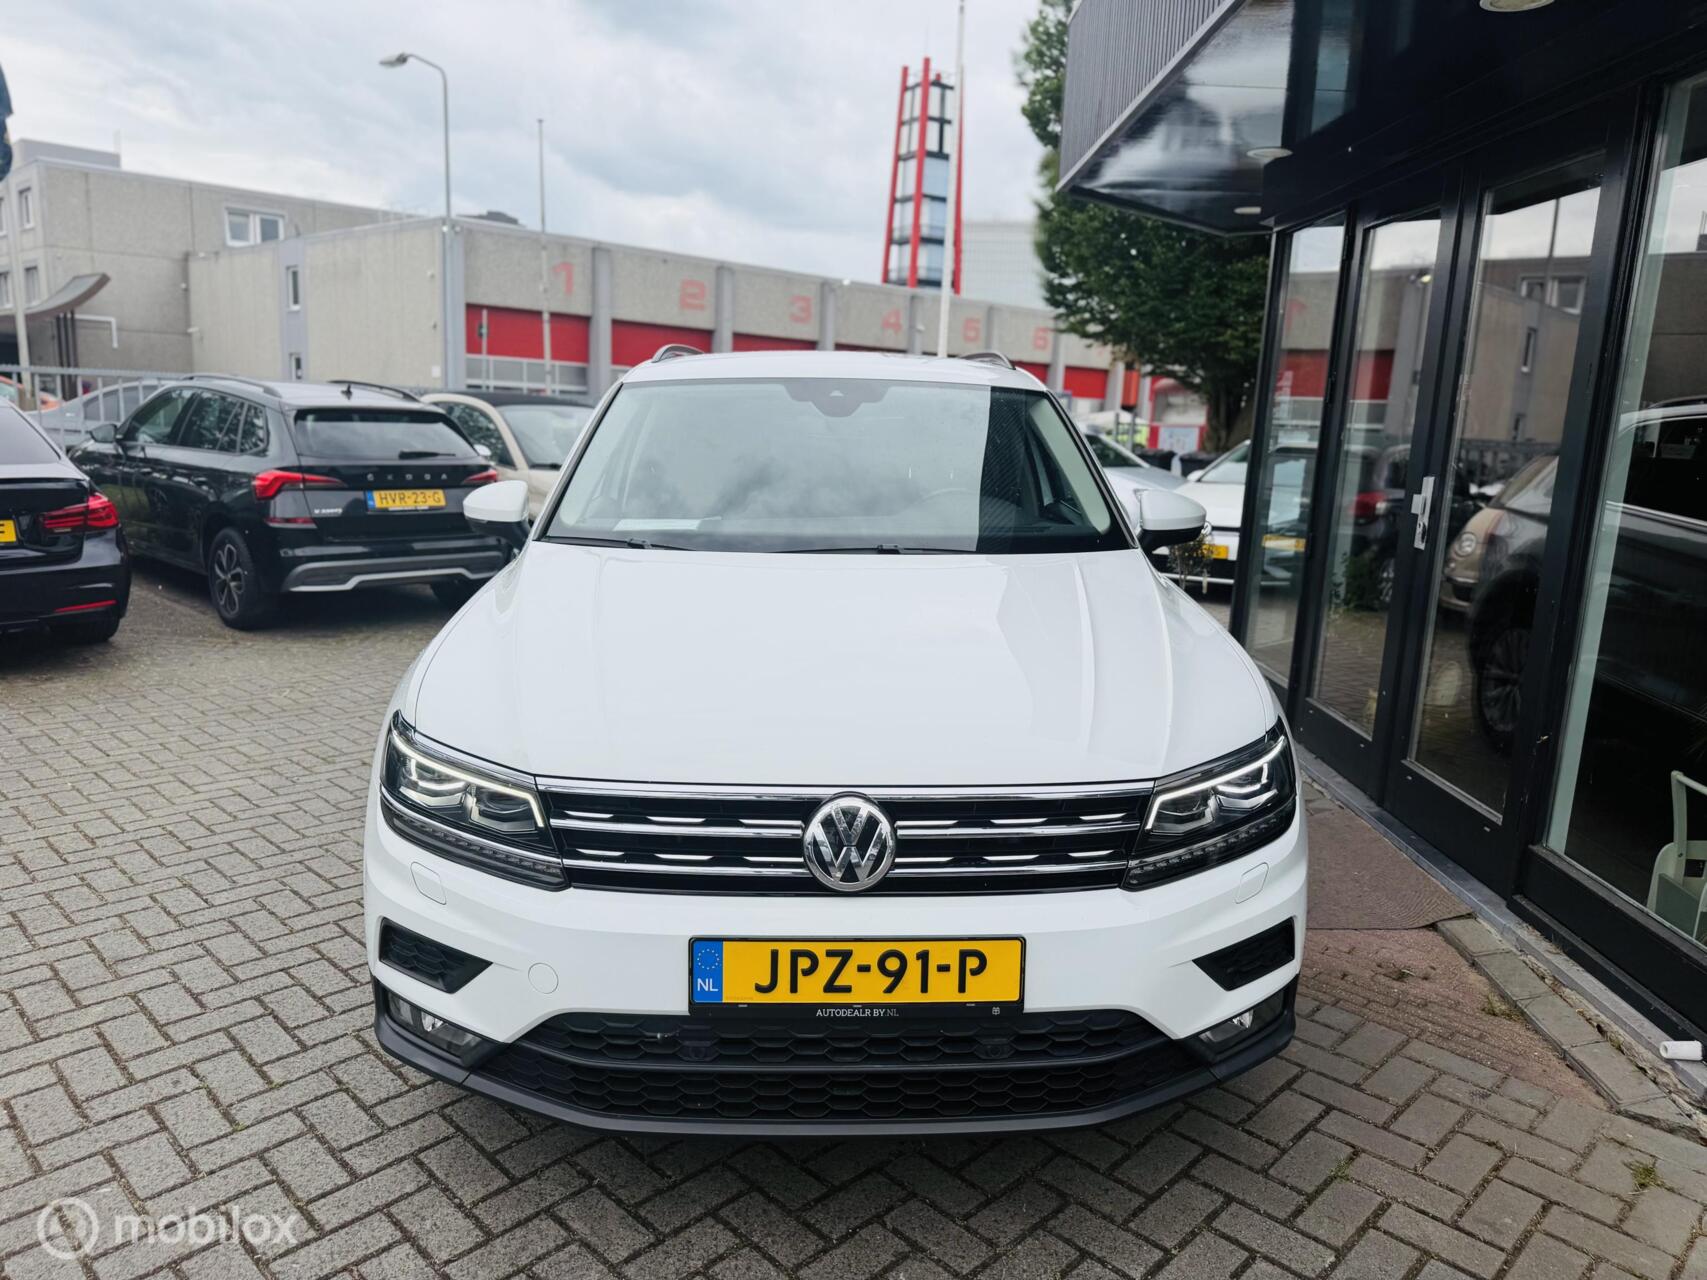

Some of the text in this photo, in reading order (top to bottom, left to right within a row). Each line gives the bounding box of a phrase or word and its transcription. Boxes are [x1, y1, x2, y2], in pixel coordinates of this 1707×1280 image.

[552, 262, 574, 296] 1
[679, 279, 706, 311] 2
[788, 295, 813, 325] 3
[881, 307, 903, 336] 4
[963, 317, 981, 344] 5
[1032, 326, 1050, 351] 6
[378, 491, 442, 505] HVR-23-G
[697, 978, 719, 992] NL
[754, 948, 989, 994] JPZ-91-P
[815, 1008, 871, 1017] AUTODEALR
